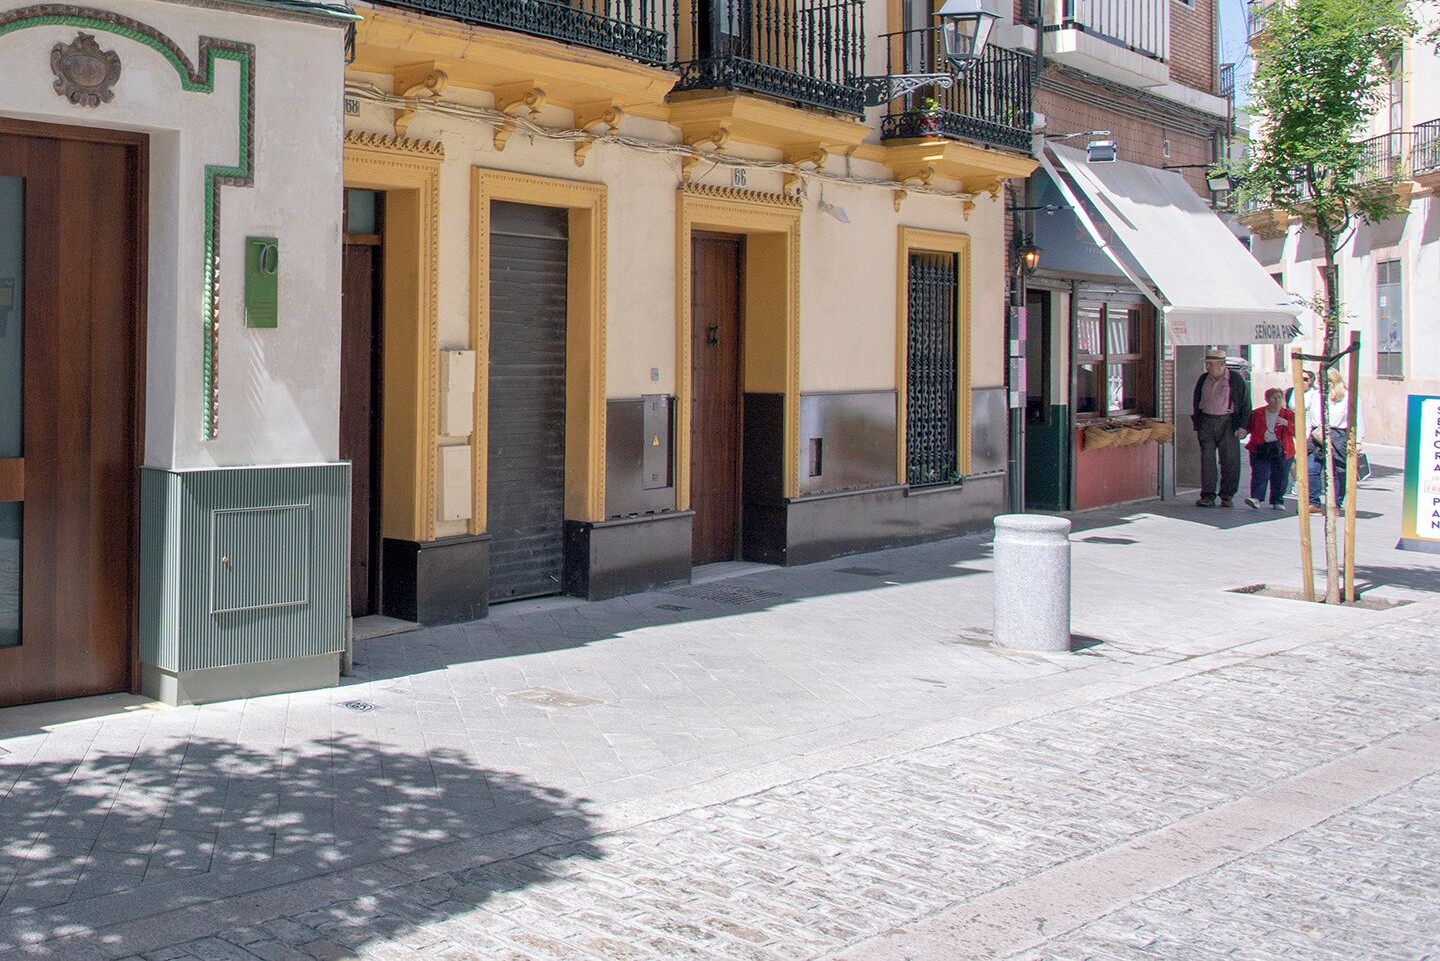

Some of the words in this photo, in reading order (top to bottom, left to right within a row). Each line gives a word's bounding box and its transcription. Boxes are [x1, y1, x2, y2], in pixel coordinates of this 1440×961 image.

[345, 98, 358, 114] 68
[734, 167, 747, 187] 66
[252, 241, 279, 275] 70
[1254, 320, 1281, 339] SEÑORA
